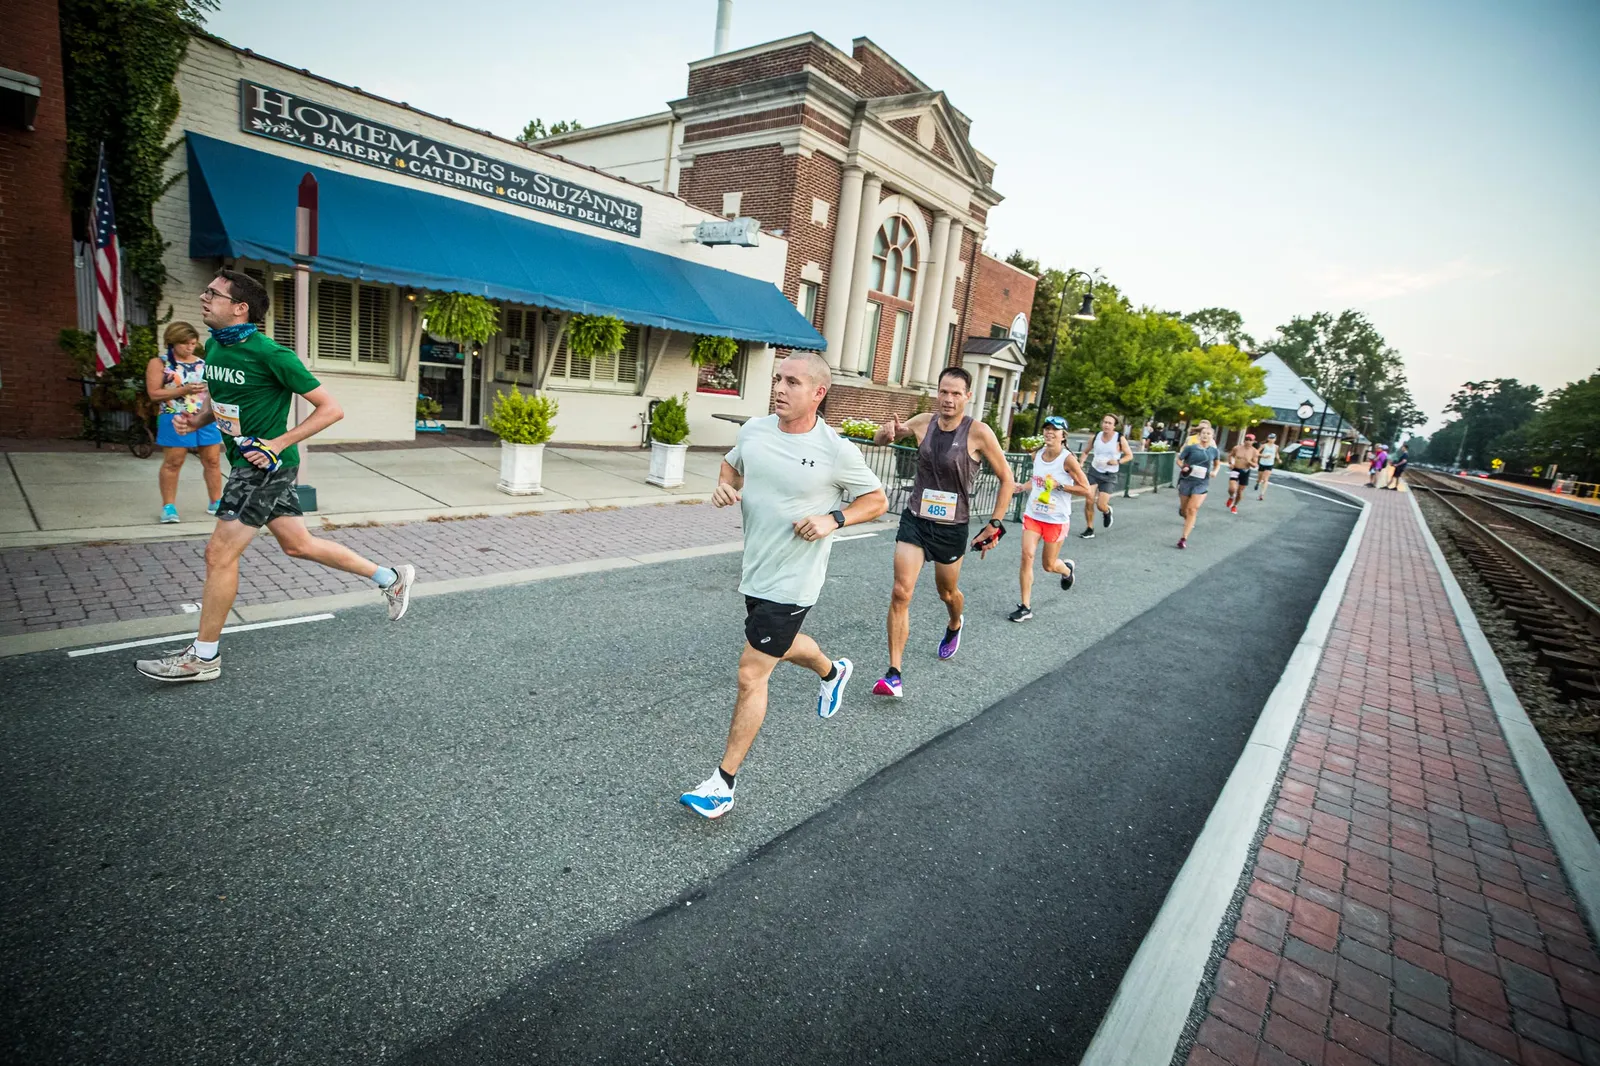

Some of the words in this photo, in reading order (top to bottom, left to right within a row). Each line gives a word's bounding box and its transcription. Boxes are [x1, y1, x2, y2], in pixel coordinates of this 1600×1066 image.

[250, 85, 505, 181] HOMEMADES
[510, 171, 529, 187] by
[533, 172, 638, 221] SUZANNE
[312, 132, 394, 165] BAKERY
[408, 160, 494, 194] CATERING
[506, 188, 576, 216] GOURMET
[577, 207, 607, 224] DELI
[927, 504, 946, 516] 485
